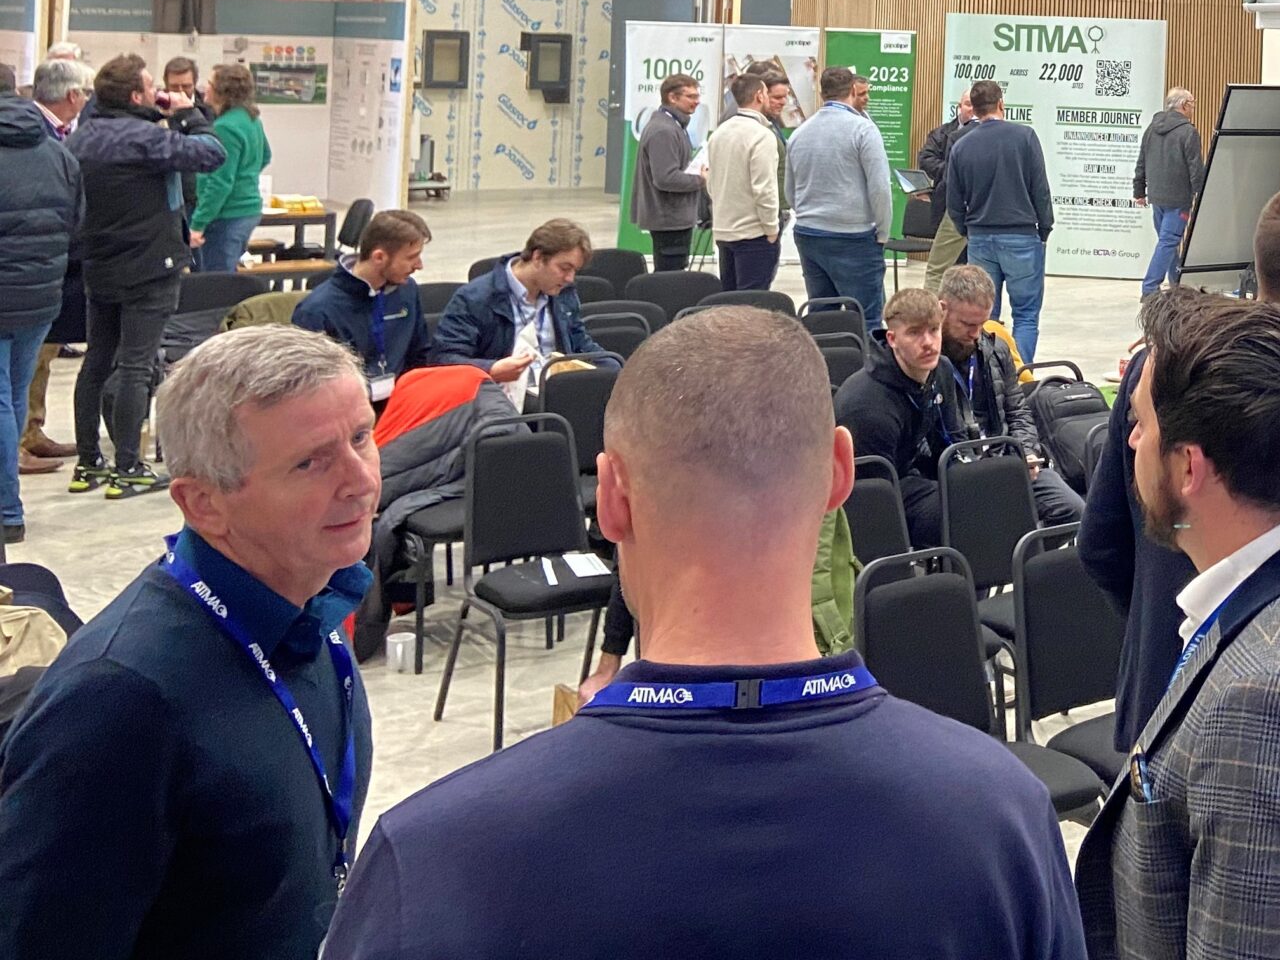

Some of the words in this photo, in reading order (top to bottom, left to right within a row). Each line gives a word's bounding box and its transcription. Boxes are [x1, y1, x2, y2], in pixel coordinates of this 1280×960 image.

[992, 23, 1088, 54] SITMA
[869, 66, 909, 82] 2023
[953, 63, 996, 80] 100,000
[1009, 68, 1029, 77] ACROSS
[1038, 63, 1083, 83] 22,000
[638, 83, 654, 93] PIR
[868, 83, 908, 92] Compliance
[1004, 107, 1032, 121] TLINE
[1056, 109, 1097, 123] MEMBER
[1100, 111, 1141, 125] JOURNEY
[1056, 247, 1070, 255] Part
[1071, 247, 1079, 255] of
[1080, 248, 1091, 256] the
[1118, 251, 1140, 259] Group
